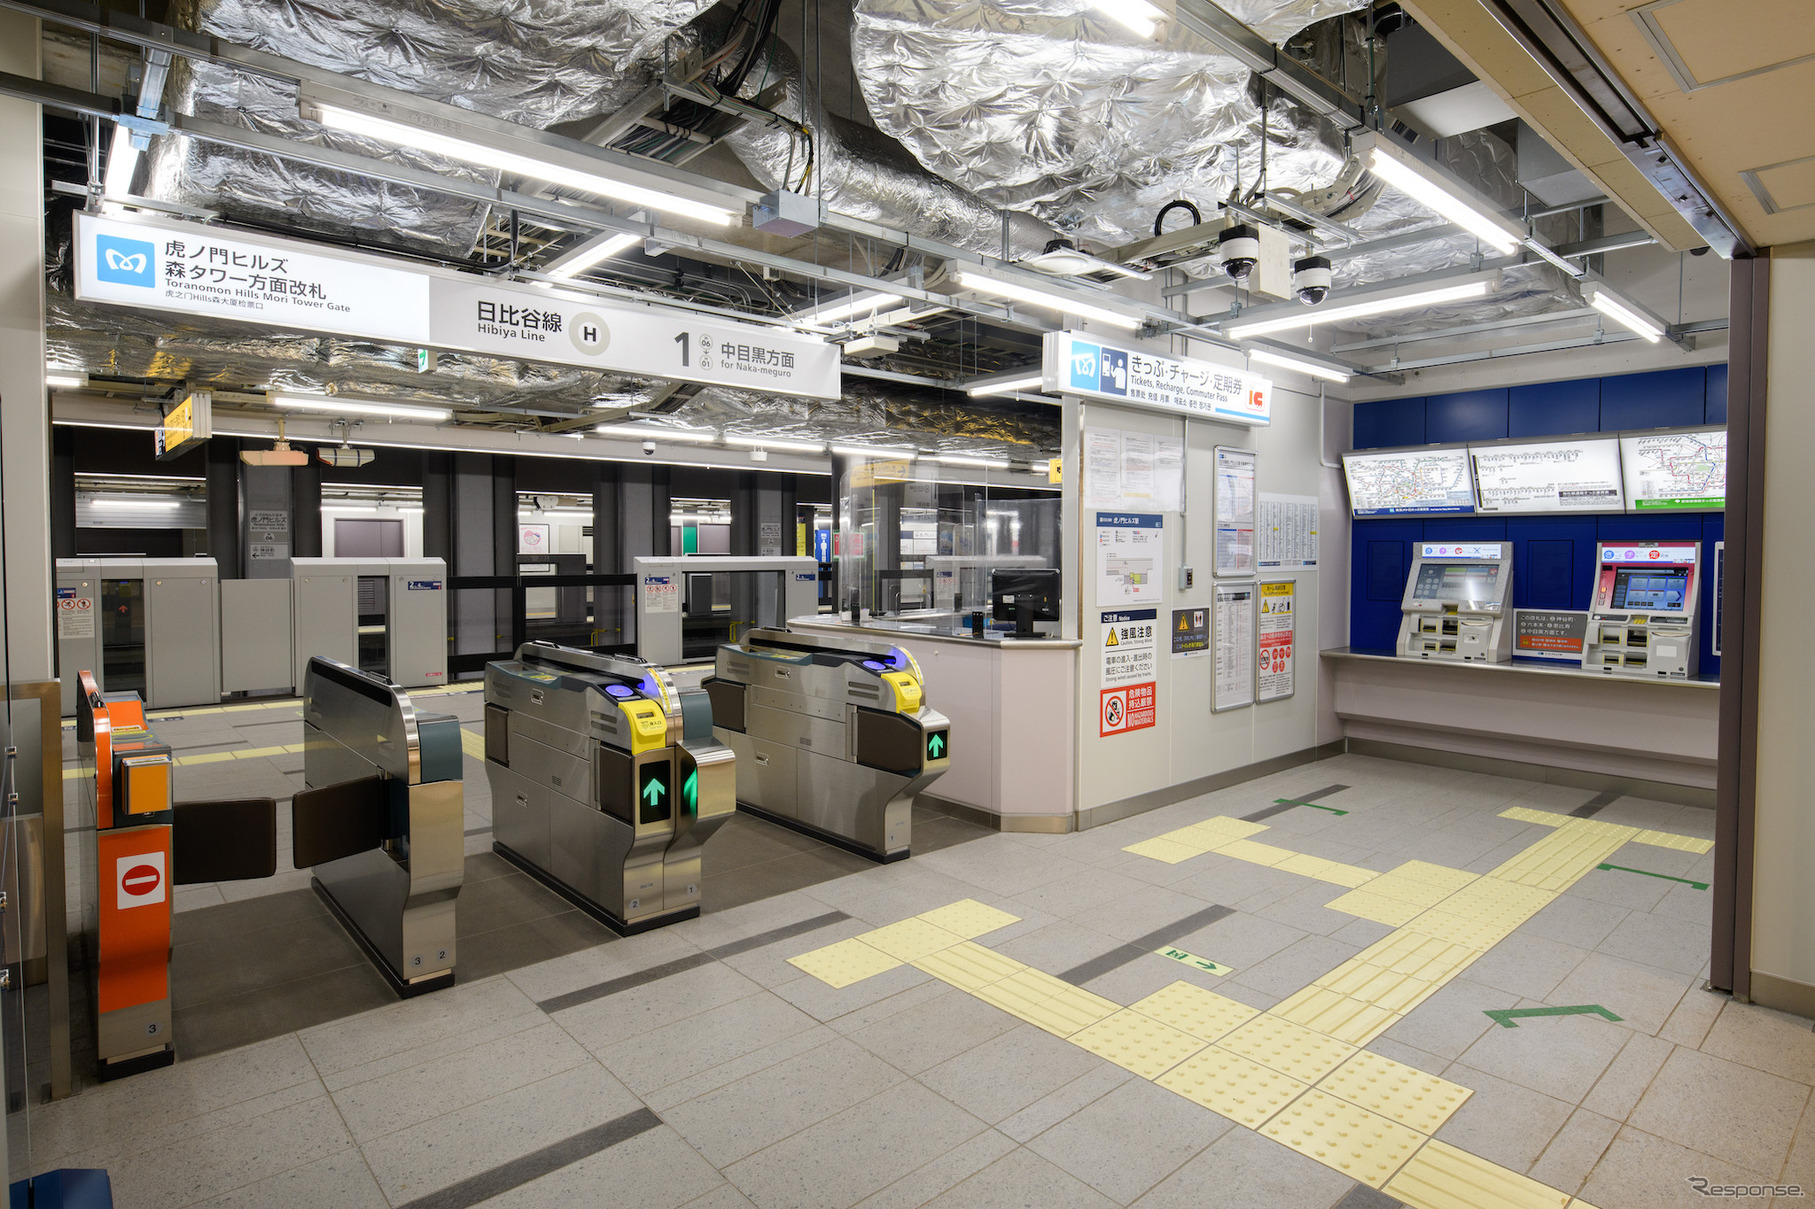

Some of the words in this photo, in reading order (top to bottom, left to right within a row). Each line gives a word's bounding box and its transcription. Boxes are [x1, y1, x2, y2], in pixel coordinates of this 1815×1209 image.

[165, 240, 288, 274] 虎ノ門ヒルズ
[165, 261, 327, 300] 森タワー方面改札
[165, 278, 232, 295] Toranomon
[235, 288, 259, 299] Hills
[263, 292, 288, 303] Mori
[291, 296, 323, 309] Tower
[327, 302, 351, 312] Gate
[478, 301, 562, 333] 日比谷線
[478, 323, 517, 339] Hibiya
[521, 329, 546, 342] Line
[583, 326, 597, 342] H
[674, 332, 689, 367] 1
[701, 339, 711, 348] 06
[701, 360, 710, 368] 01
[721, 342, 795, 369] 中目黒方面
[721, 359, 734, 370] for
[736, 362, 792, 378] Naka-meguro
[1132, 356, 1243, 396] きっぷ・チャージ・定期券
[1131, 375, 1155, 390] Tickets,
[1155, 380, 1186, 396] Recharge,
[1186, 386, 1216, 401] Commuter
[1216, 392, 1229, 403] Pass
[1121, 626, 1153, 640] 強風注意
[415, 957, 421, 965] 3
[439, 951, 445, 959] 2
[149, 1024, 157, 1034] 3
